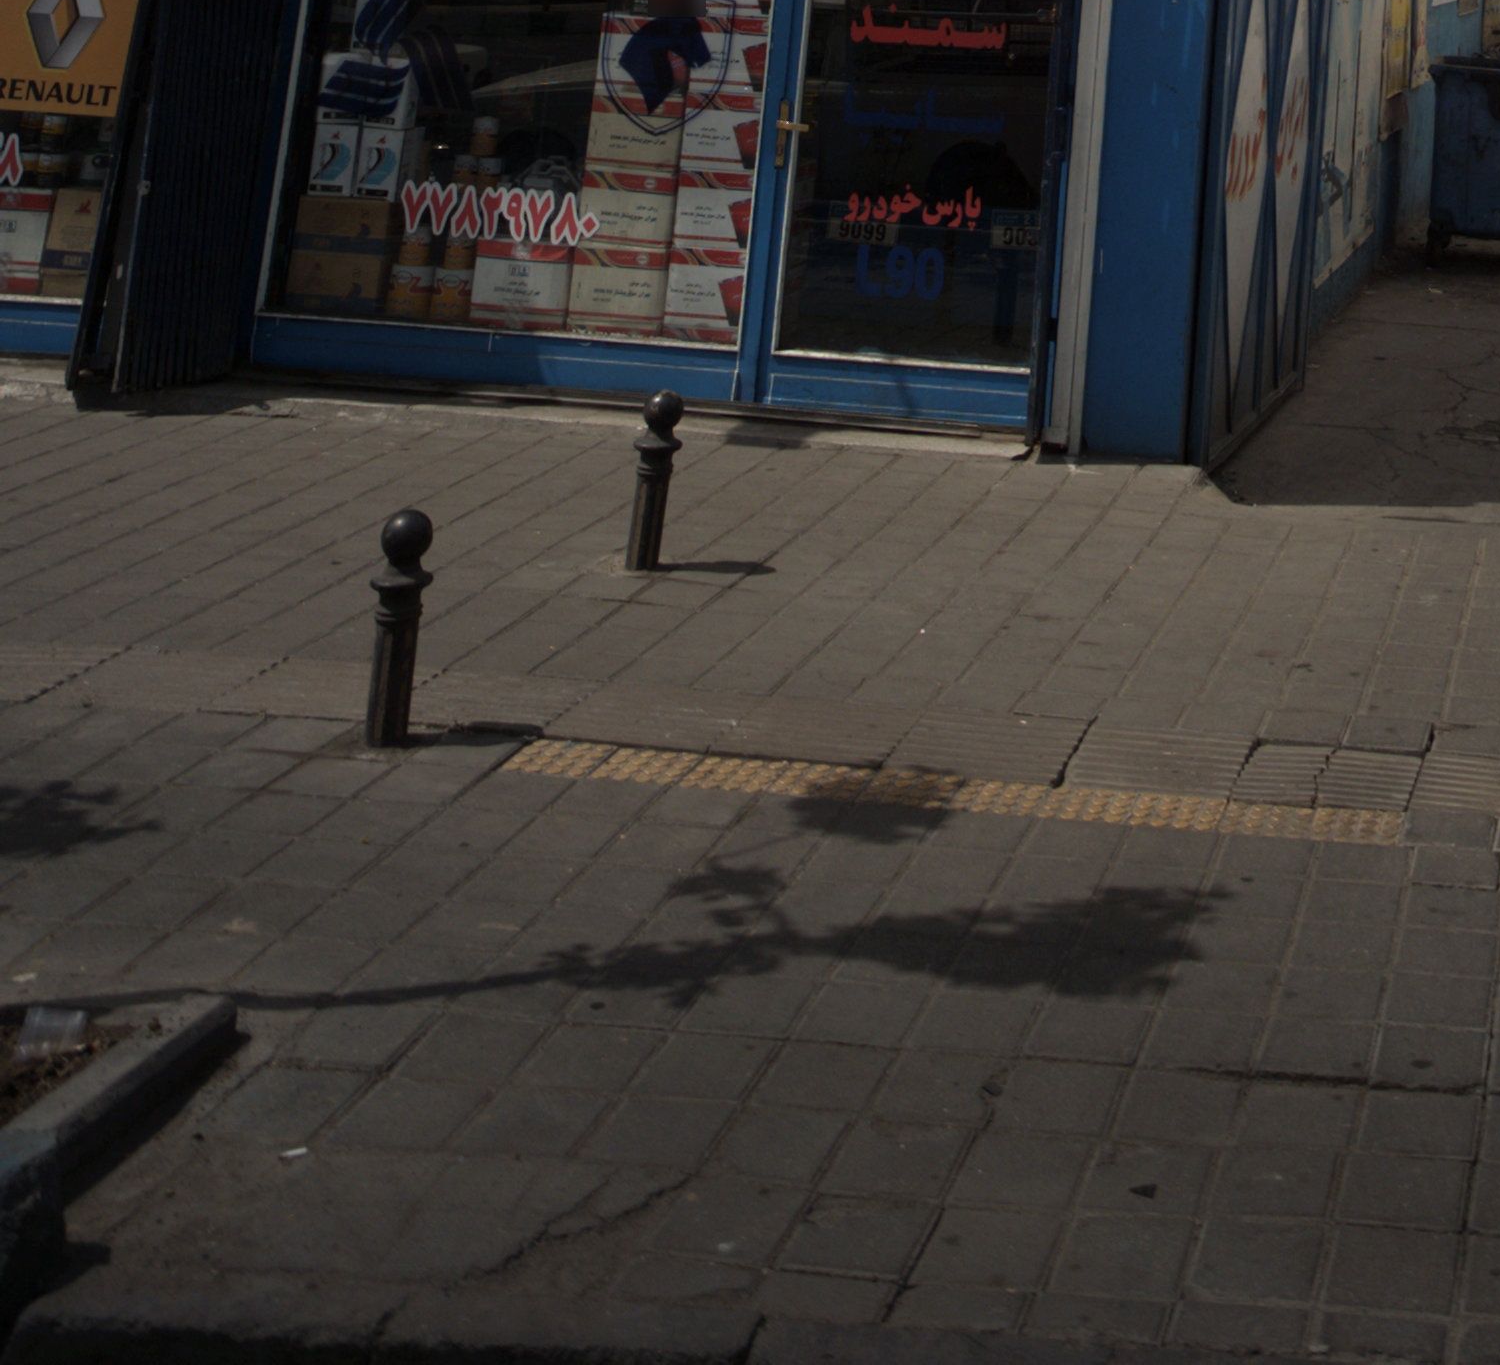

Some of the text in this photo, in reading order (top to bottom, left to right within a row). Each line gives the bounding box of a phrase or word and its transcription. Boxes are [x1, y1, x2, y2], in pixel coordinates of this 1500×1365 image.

[850, 3, 1008, 50] سمند
[400, 180, 601, 246] ۷۷۸۲۹۷۸۰
[842, 182, 984, 231] پارس خودرو
[856, 244, 945, 300] L90
